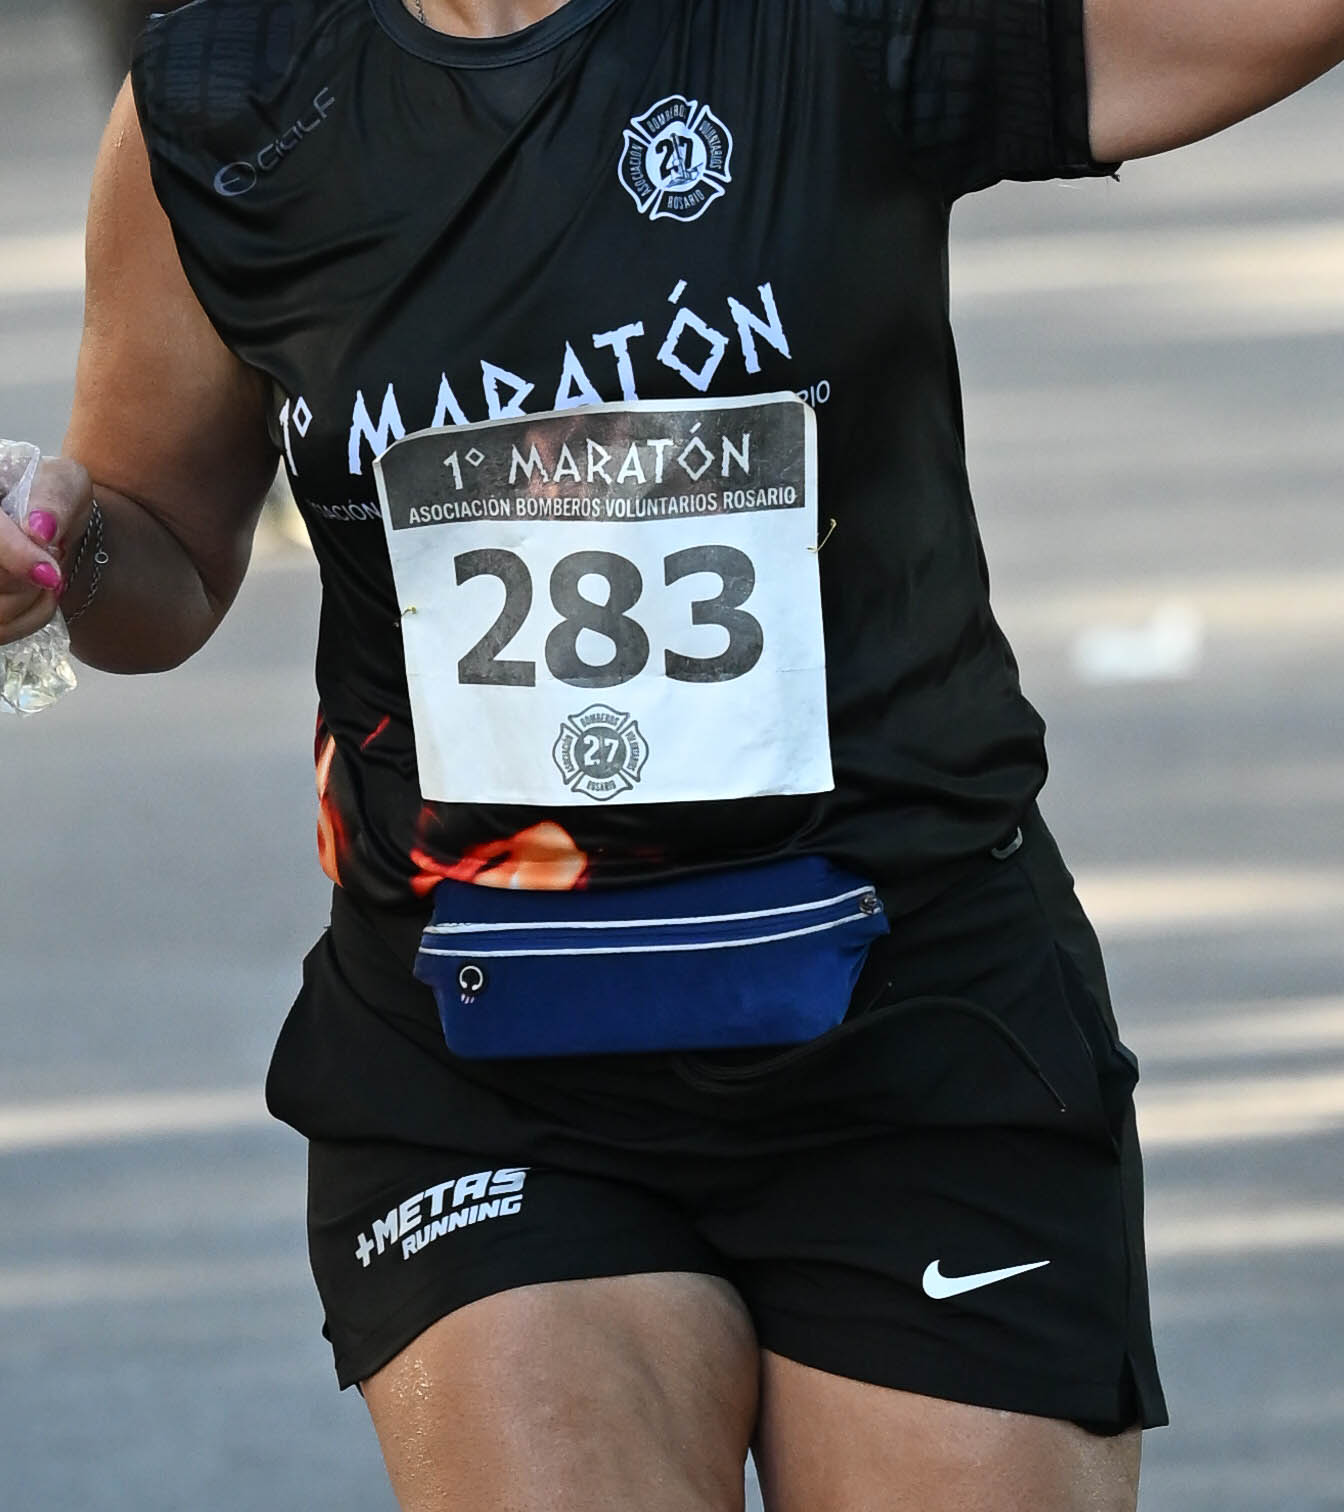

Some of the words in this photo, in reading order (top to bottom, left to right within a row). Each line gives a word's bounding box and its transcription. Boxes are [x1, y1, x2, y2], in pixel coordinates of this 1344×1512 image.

[348, 280, 792, 475] MARATÓN
[509, 422, 752, 485] MARATÓN
[409, 494, 511, 524] ASOCIACIÓN
[515, 497, 601, 519] BOMBEROS
[605, 492, 718, 518] VOLUNTARIOS
[723, 486, 797, 510] ROSARIO
[453, 544, 765, 688] 283
[583, 734, 619, 766] 27
[401, 1194, 524, 1261] RUNNING
